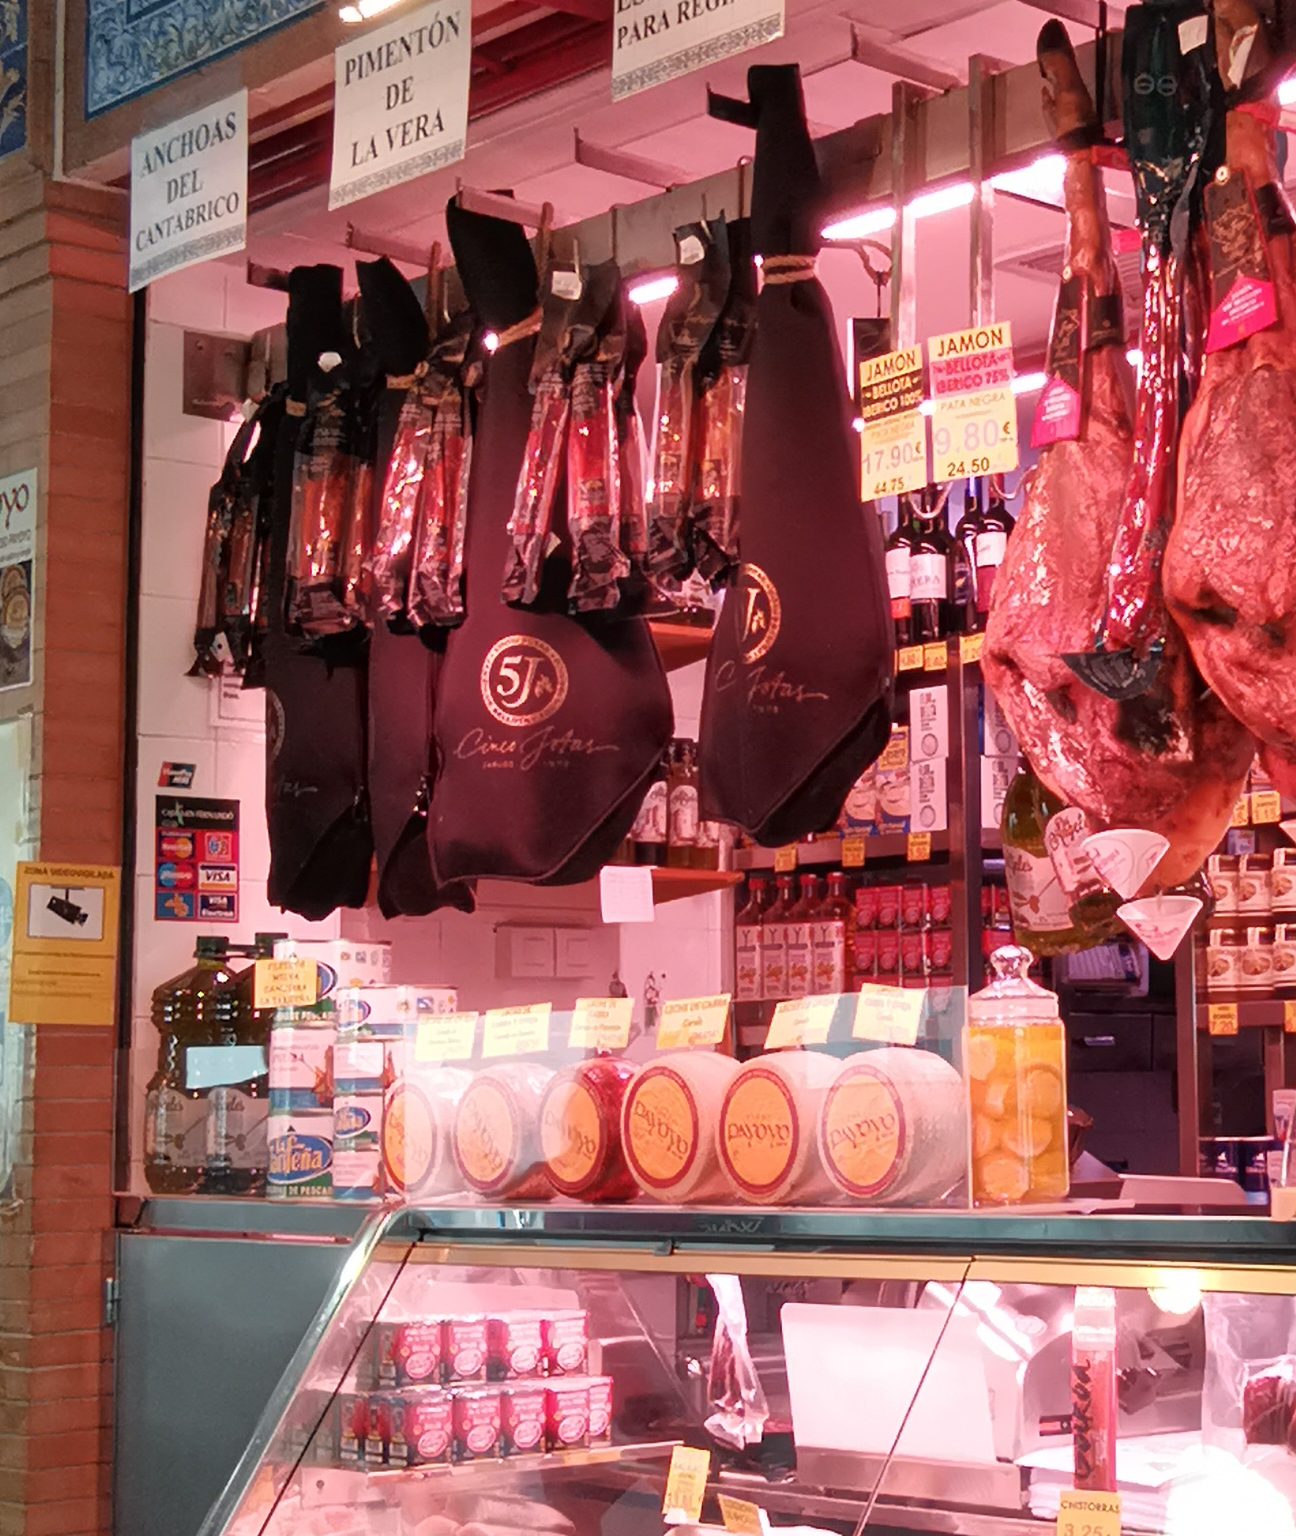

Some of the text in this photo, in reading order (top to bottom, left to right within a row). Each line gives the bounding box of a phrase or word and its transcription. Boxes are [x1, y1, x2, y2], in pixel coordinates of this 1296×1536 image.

[344, 10, 460, 86] PIMENTÓN
[616, 13, 670, 50] PARA
[386, 76, 414, 111] DE
[140, 112, 236, 179] ANCHOAS
[351, 109, 445, 167] LA VERA
[167, 169, 203, 204] DEL
[135, 191, 239, 253] CANTABRICO
[938, 329, 1003, 357] JAMON
[867, 350, 916, 381] JAMON
[872, 377, 912, 399] BELLOTA
[948, 457, 990, 477] 24.50
[496, 655, 545, 708] 5J
[205, 871, 231, 882] VISA
[1060, 1500, 1119, 1514] CHISTORRAS
